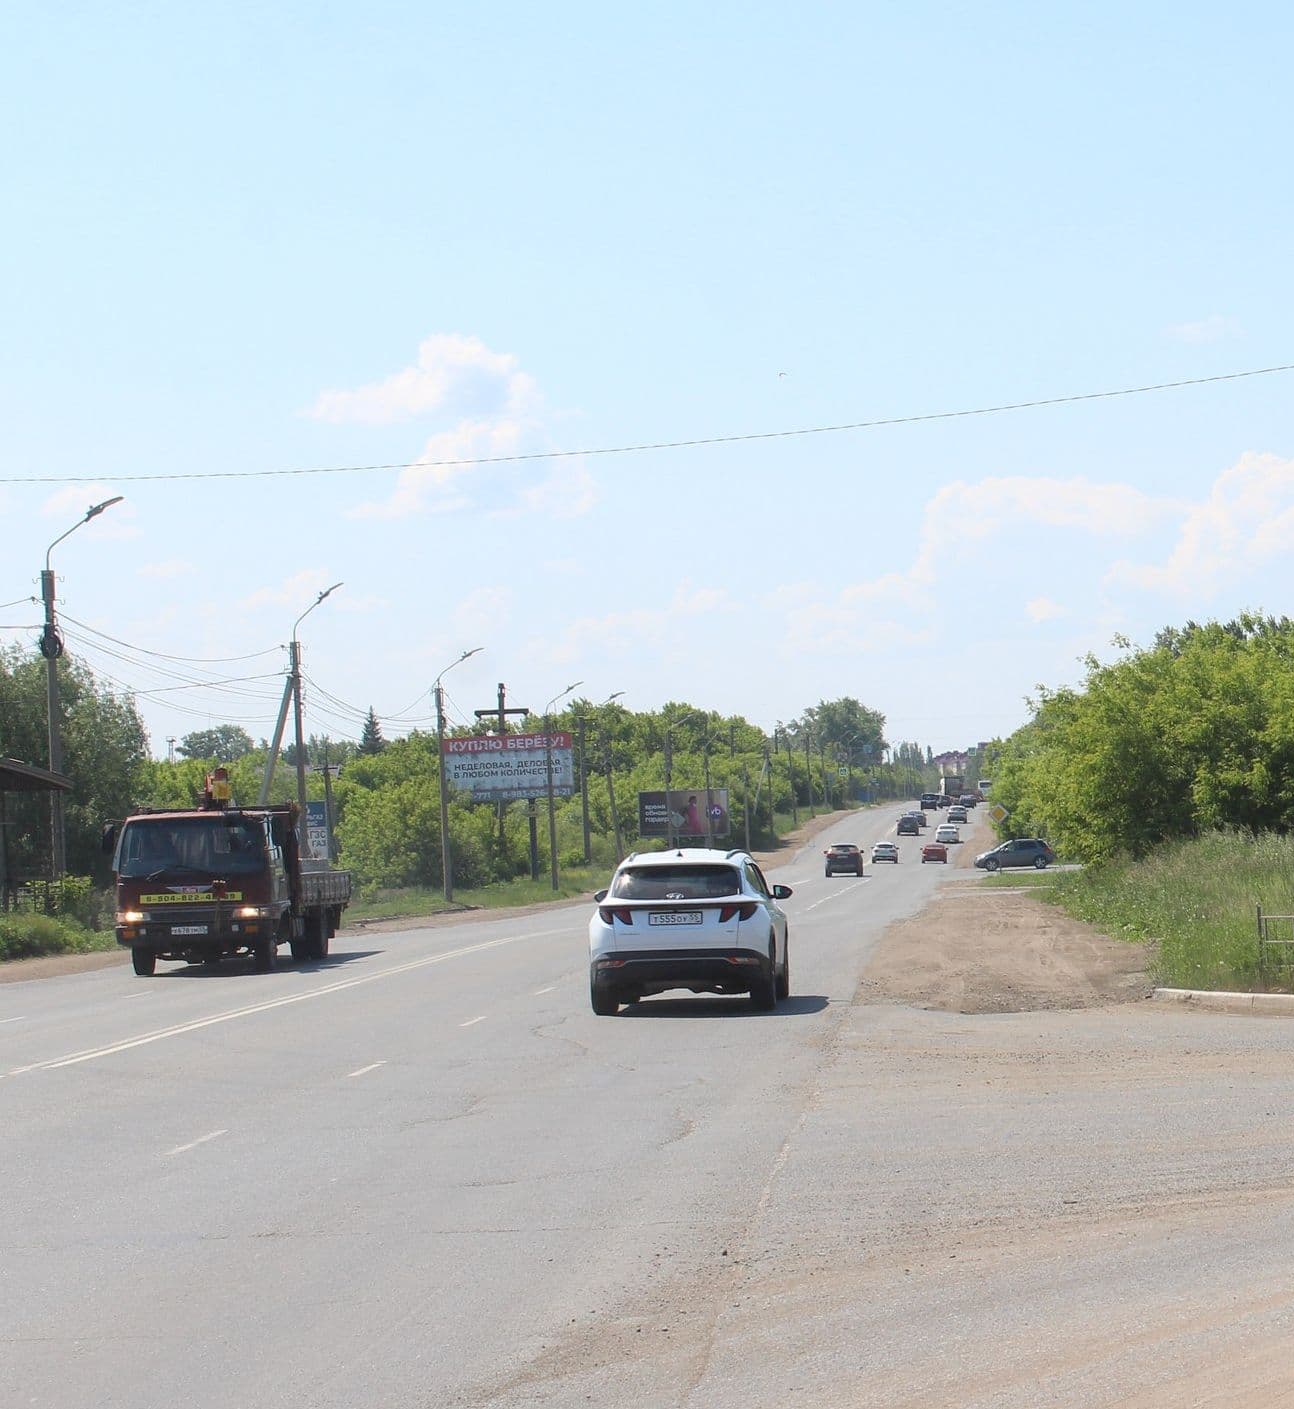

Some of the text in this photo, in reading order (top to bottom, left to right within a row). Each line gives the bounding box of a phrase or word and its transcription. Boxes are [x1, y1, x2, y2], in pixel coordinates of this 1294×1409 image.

[449, 740, 502, 752] КУПЛЮ
[454, 761, 512, 771] НЕДЕЛОВАЯ,
[462, 770, 498, 779] ЛЮБОМ
[501, 766, 562, 777] КОЛИЧЕСТЕ!
